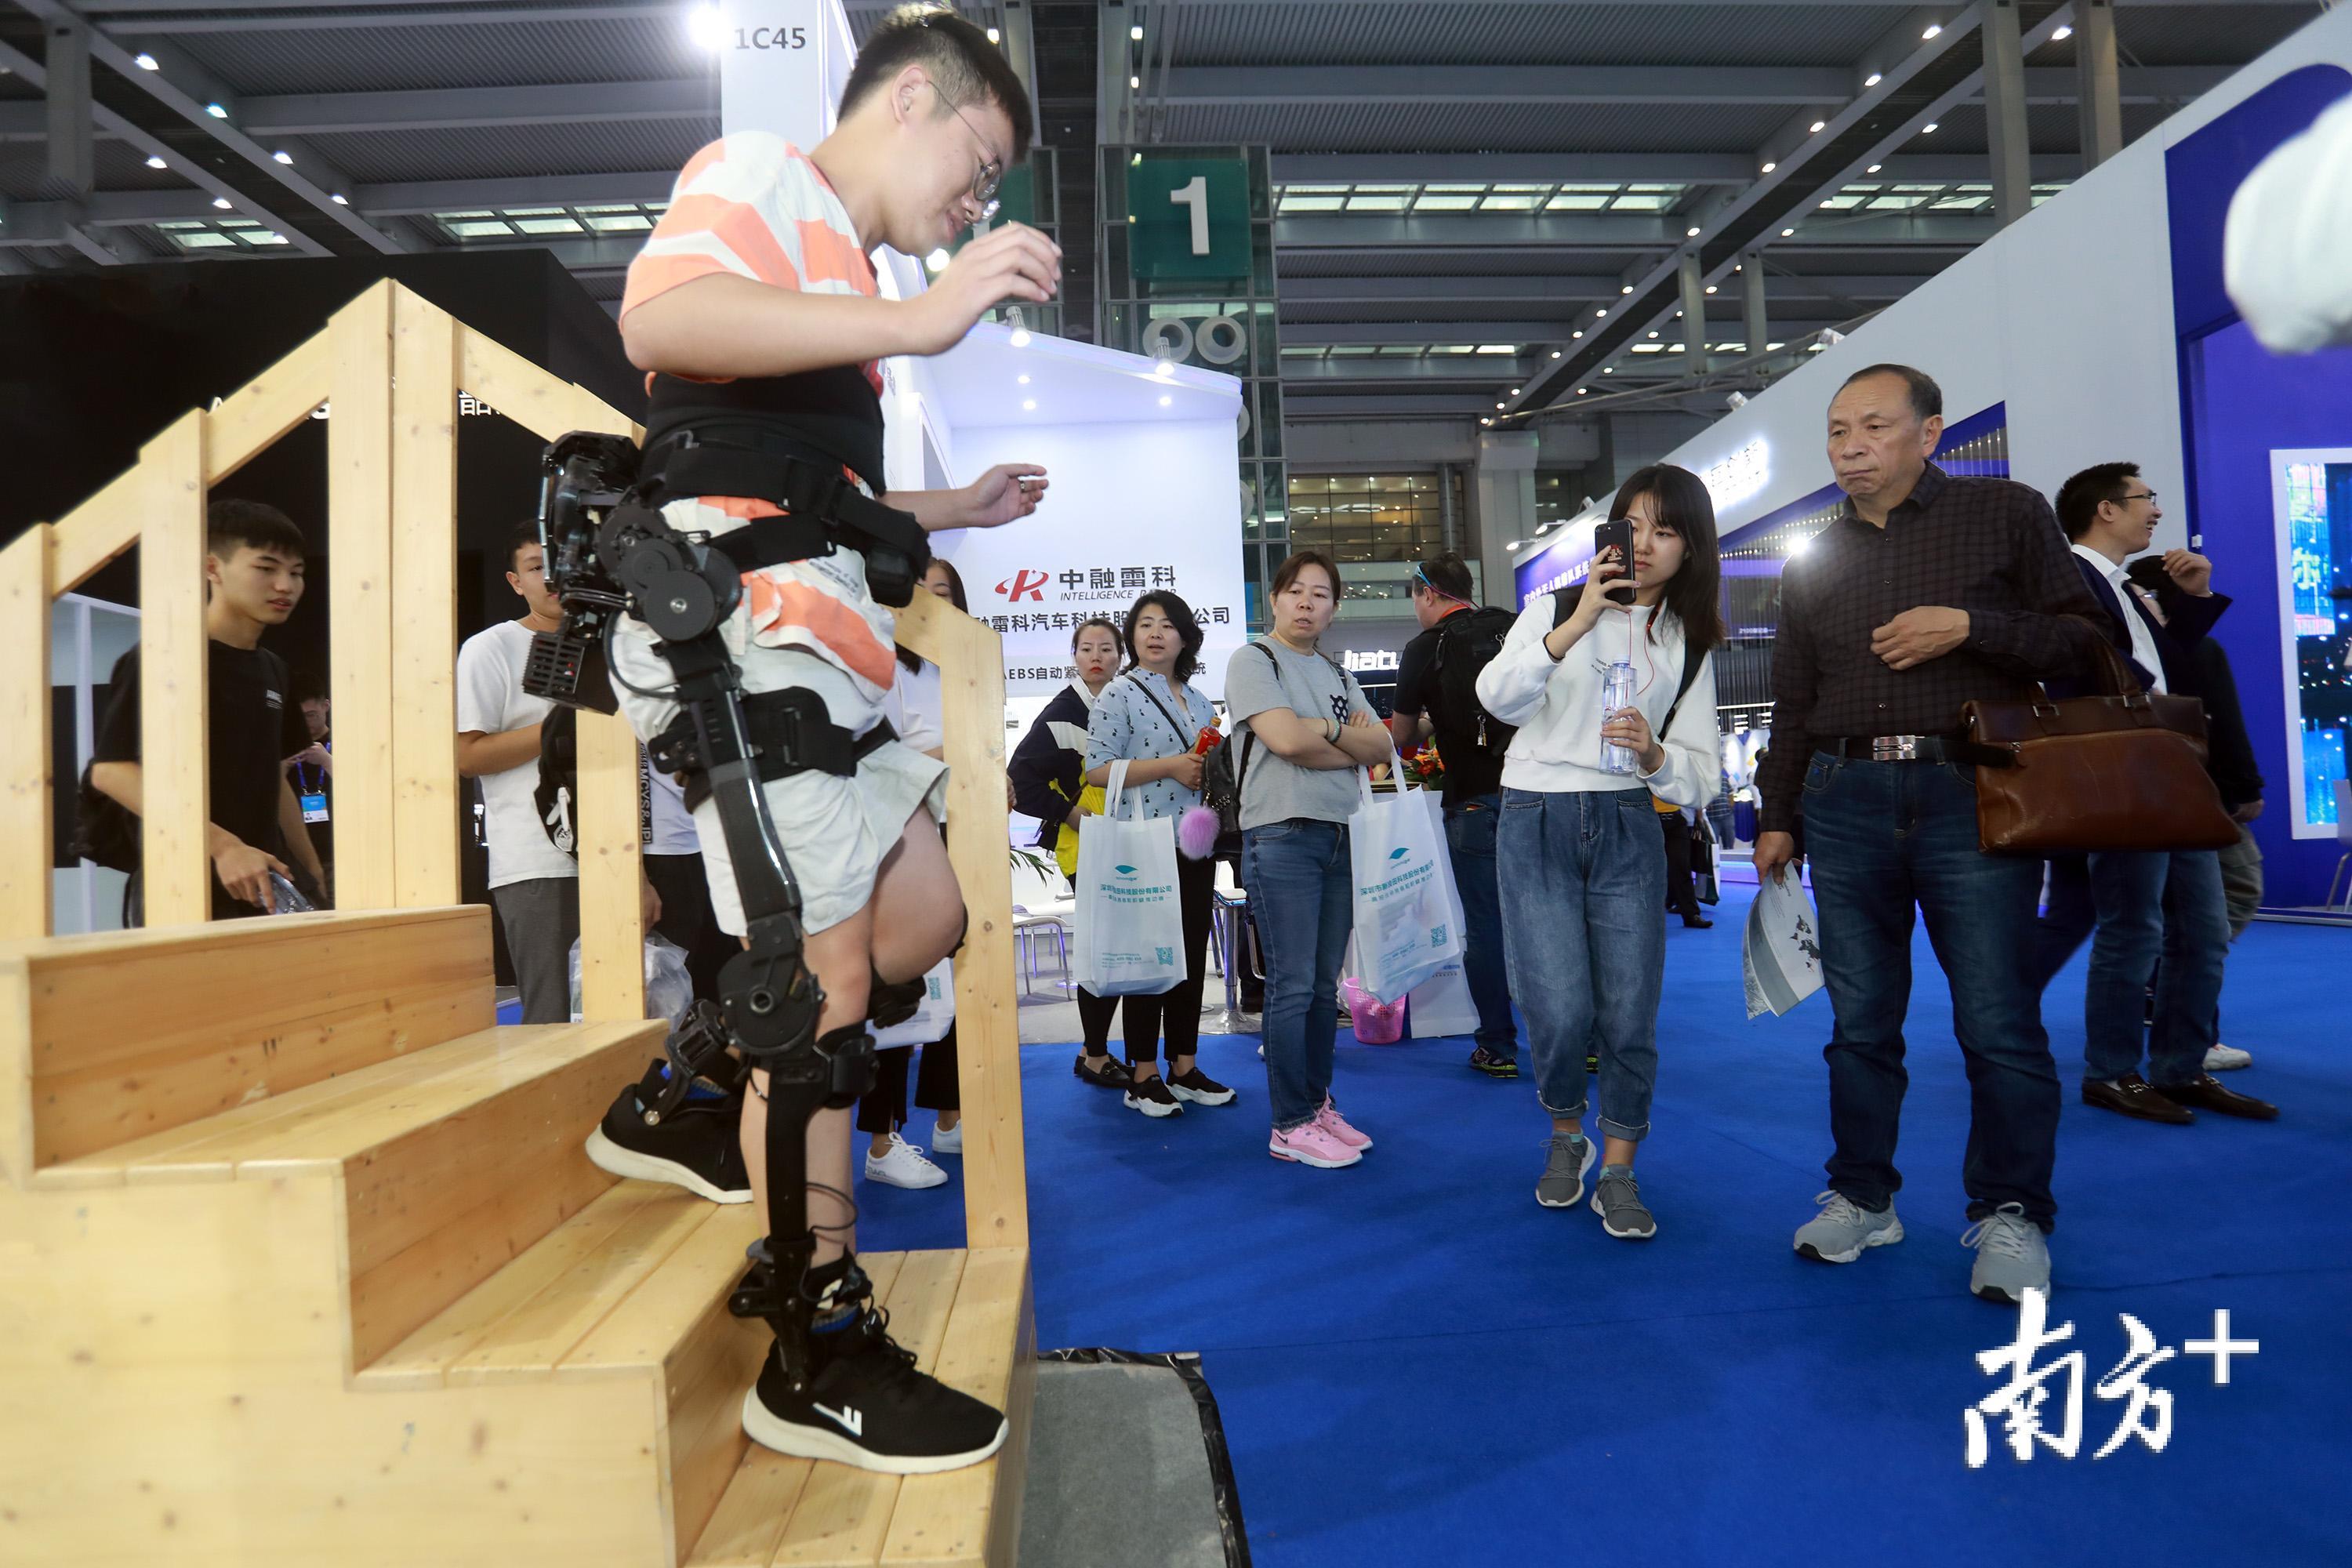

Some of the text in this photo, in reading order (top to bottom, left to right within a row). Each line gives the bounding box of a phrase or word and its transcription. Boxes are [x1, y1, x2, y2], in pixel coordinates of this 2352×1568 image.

[735, 27, 806, 49] 1C45
[1171, 176, 1210, 256] 1
[1059, 565, 1176, 590] 中融雷科
[1060, 589, 1134, 601] INTELLIGENCE
